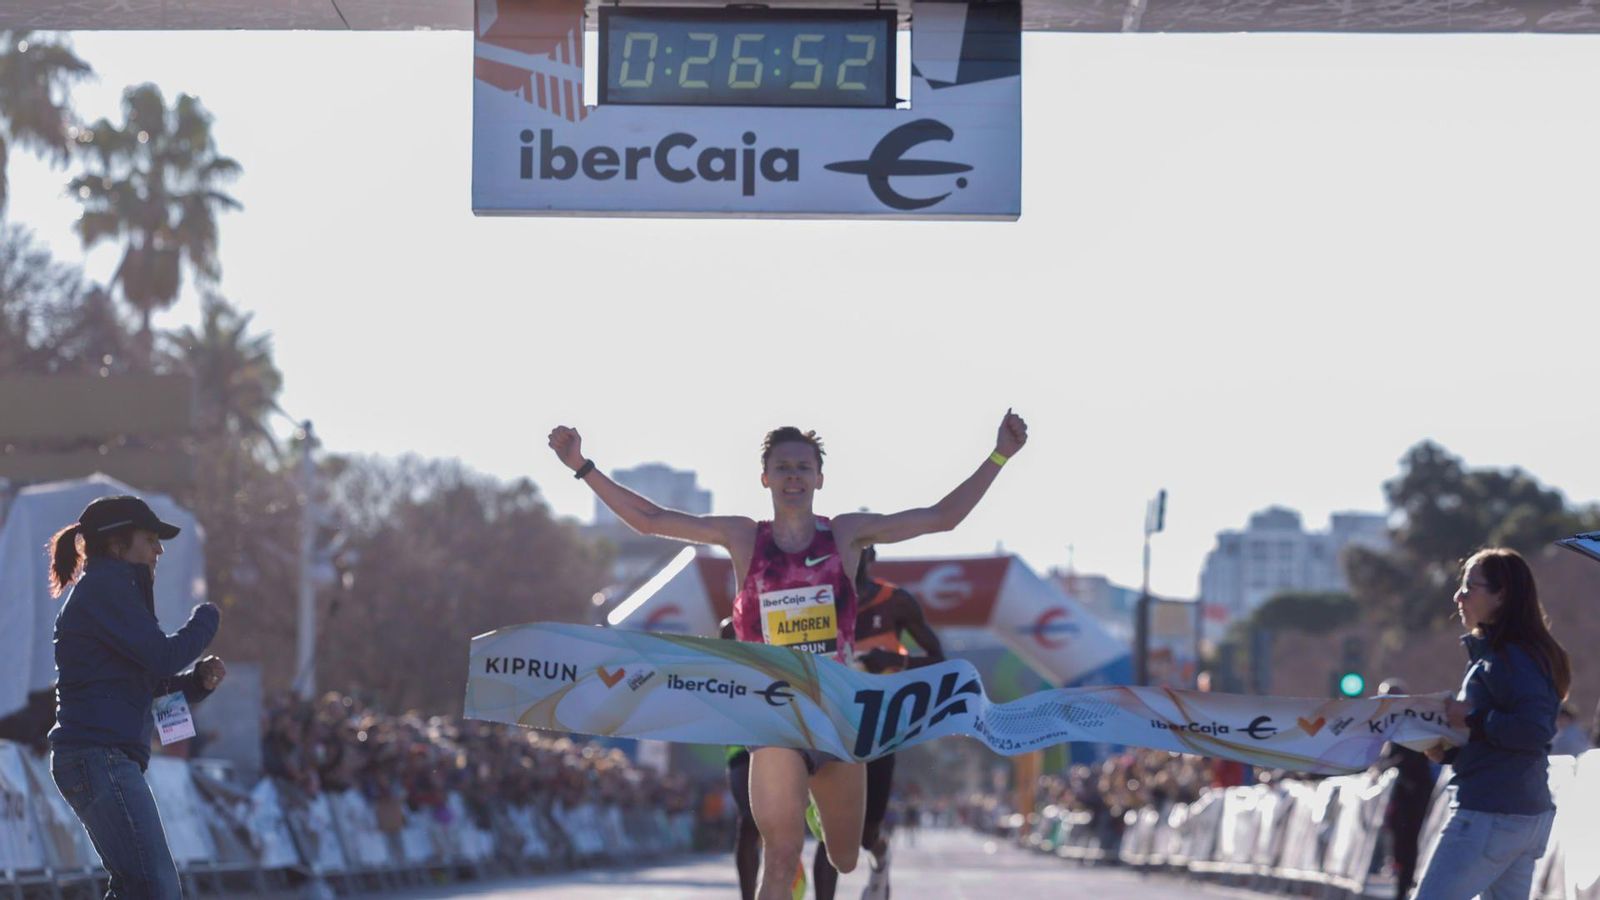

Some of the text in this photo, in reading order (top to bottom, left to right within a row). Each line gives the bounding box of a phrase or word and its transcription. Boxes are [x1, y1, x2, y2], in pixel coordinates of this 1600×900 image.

[618, 31, 877, 91] 0:26:52
[518, 128, 800, 197] iberCaja
[763, 594, 806, 608] iberCaja
[777, 616, 830, 635] ALMGREN
[485, 656, 578, 683] KIPRUN
[666, 674, 748, 700] iberCaja
[1150, 719, 1230, 737] iberCaja
